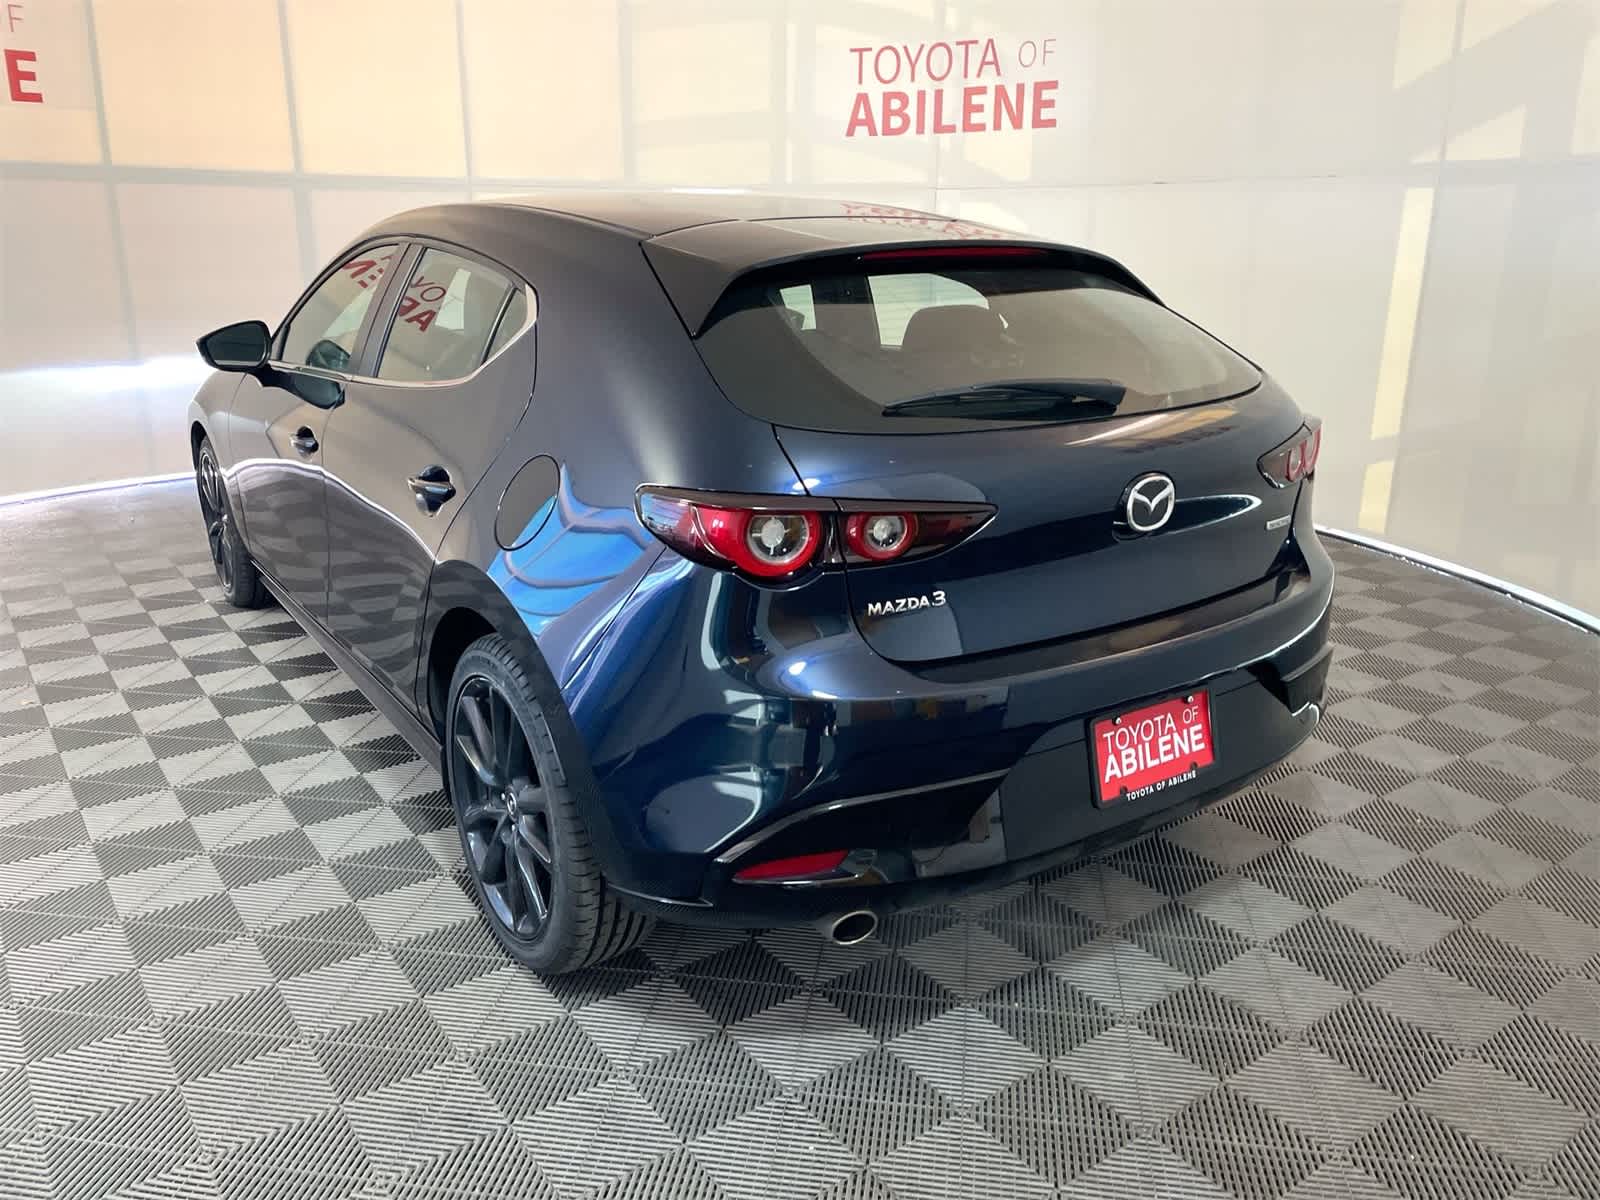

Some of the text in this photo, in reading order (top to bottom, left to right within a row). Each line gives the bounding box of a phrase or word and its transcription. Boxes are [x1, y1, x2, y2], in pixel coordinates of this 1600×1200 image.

[849, 38, 1057, 85] TOYOTA OF
[845, 80, 1059, 137] ABILENE
[1102, 705, 1199, 754] TOYOTA OF
[1104, 723, 1206, 784] ABILENE
[1126, 769, 1197, 801] TOYOTA OF ABILENE
